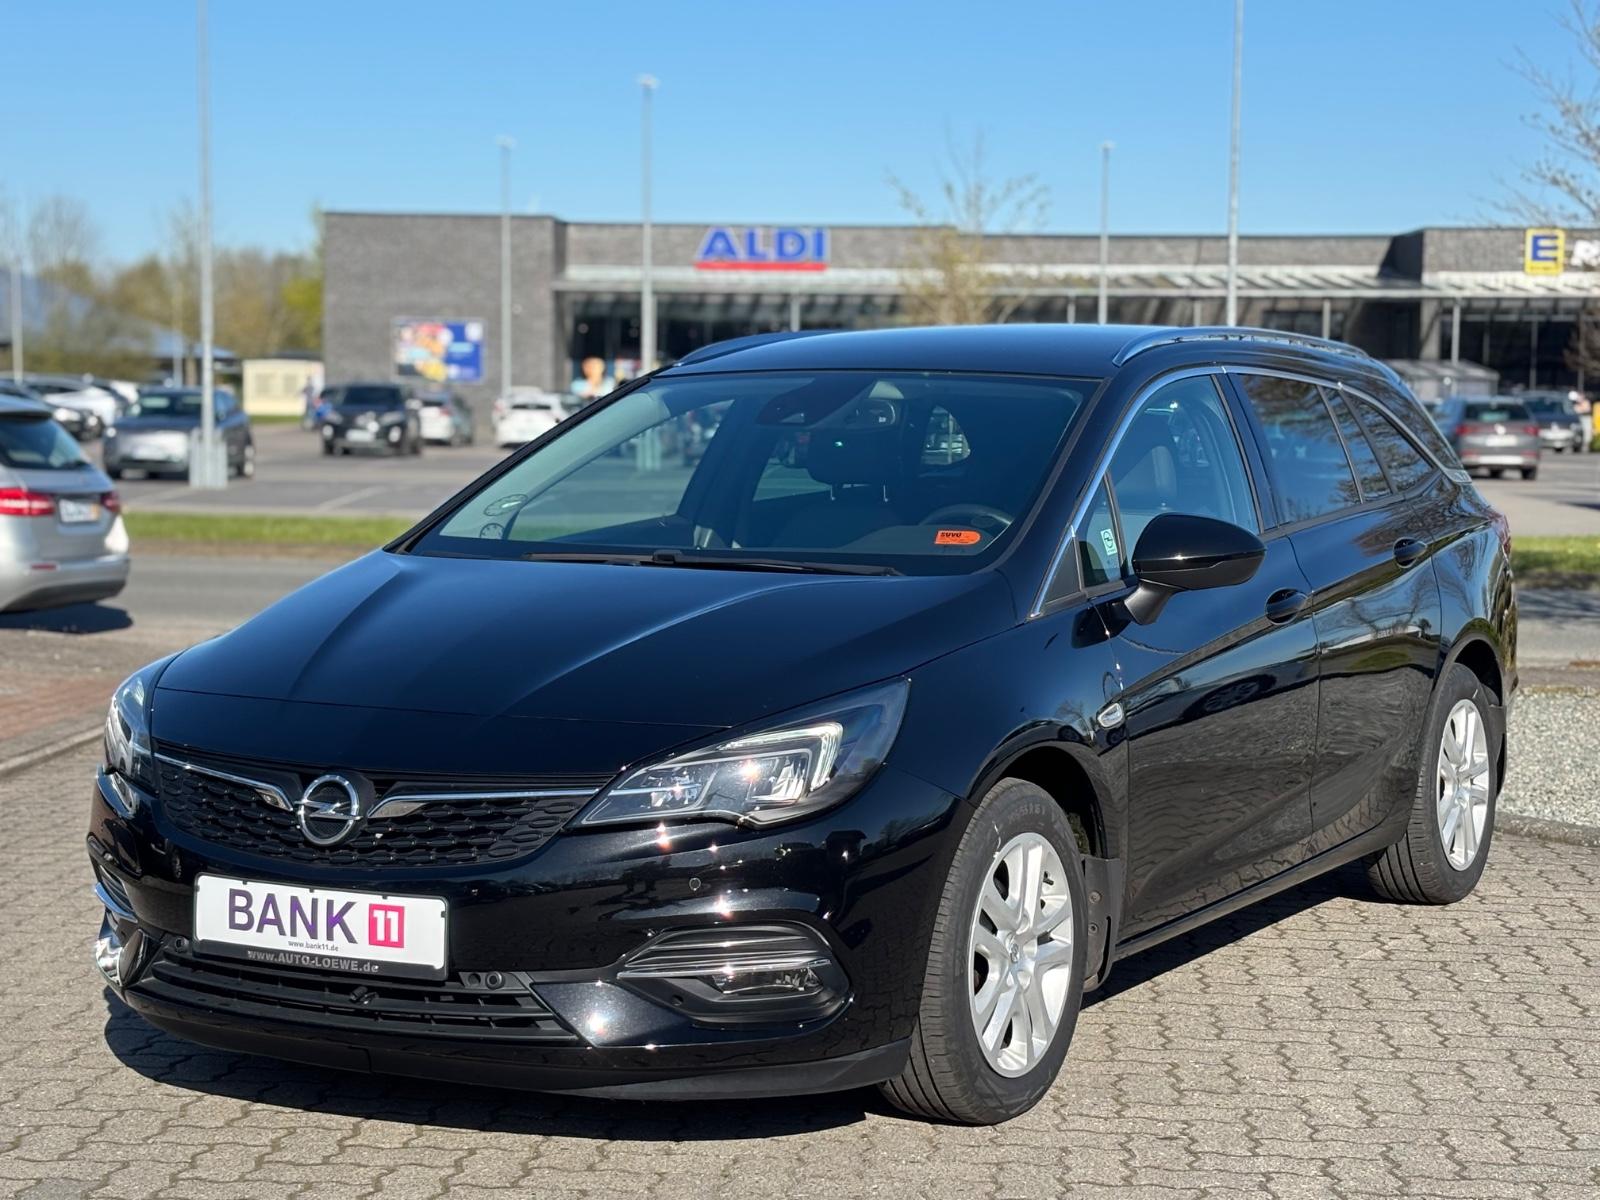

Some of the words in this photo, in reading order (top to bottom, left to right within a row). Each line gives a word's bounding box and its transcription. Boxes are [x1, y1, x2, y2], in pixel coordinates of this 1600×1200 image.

[700, 228, 828, 261] ALDI
[1531, 235, 1558, 261] E
[228, 888, 357, 944] BANK
[372, 909, 399, 942] 11
[288, 940, 339, 952] www.bank11.de
[247, 950, 379, 973] www.AUTO-LOEWE.de
